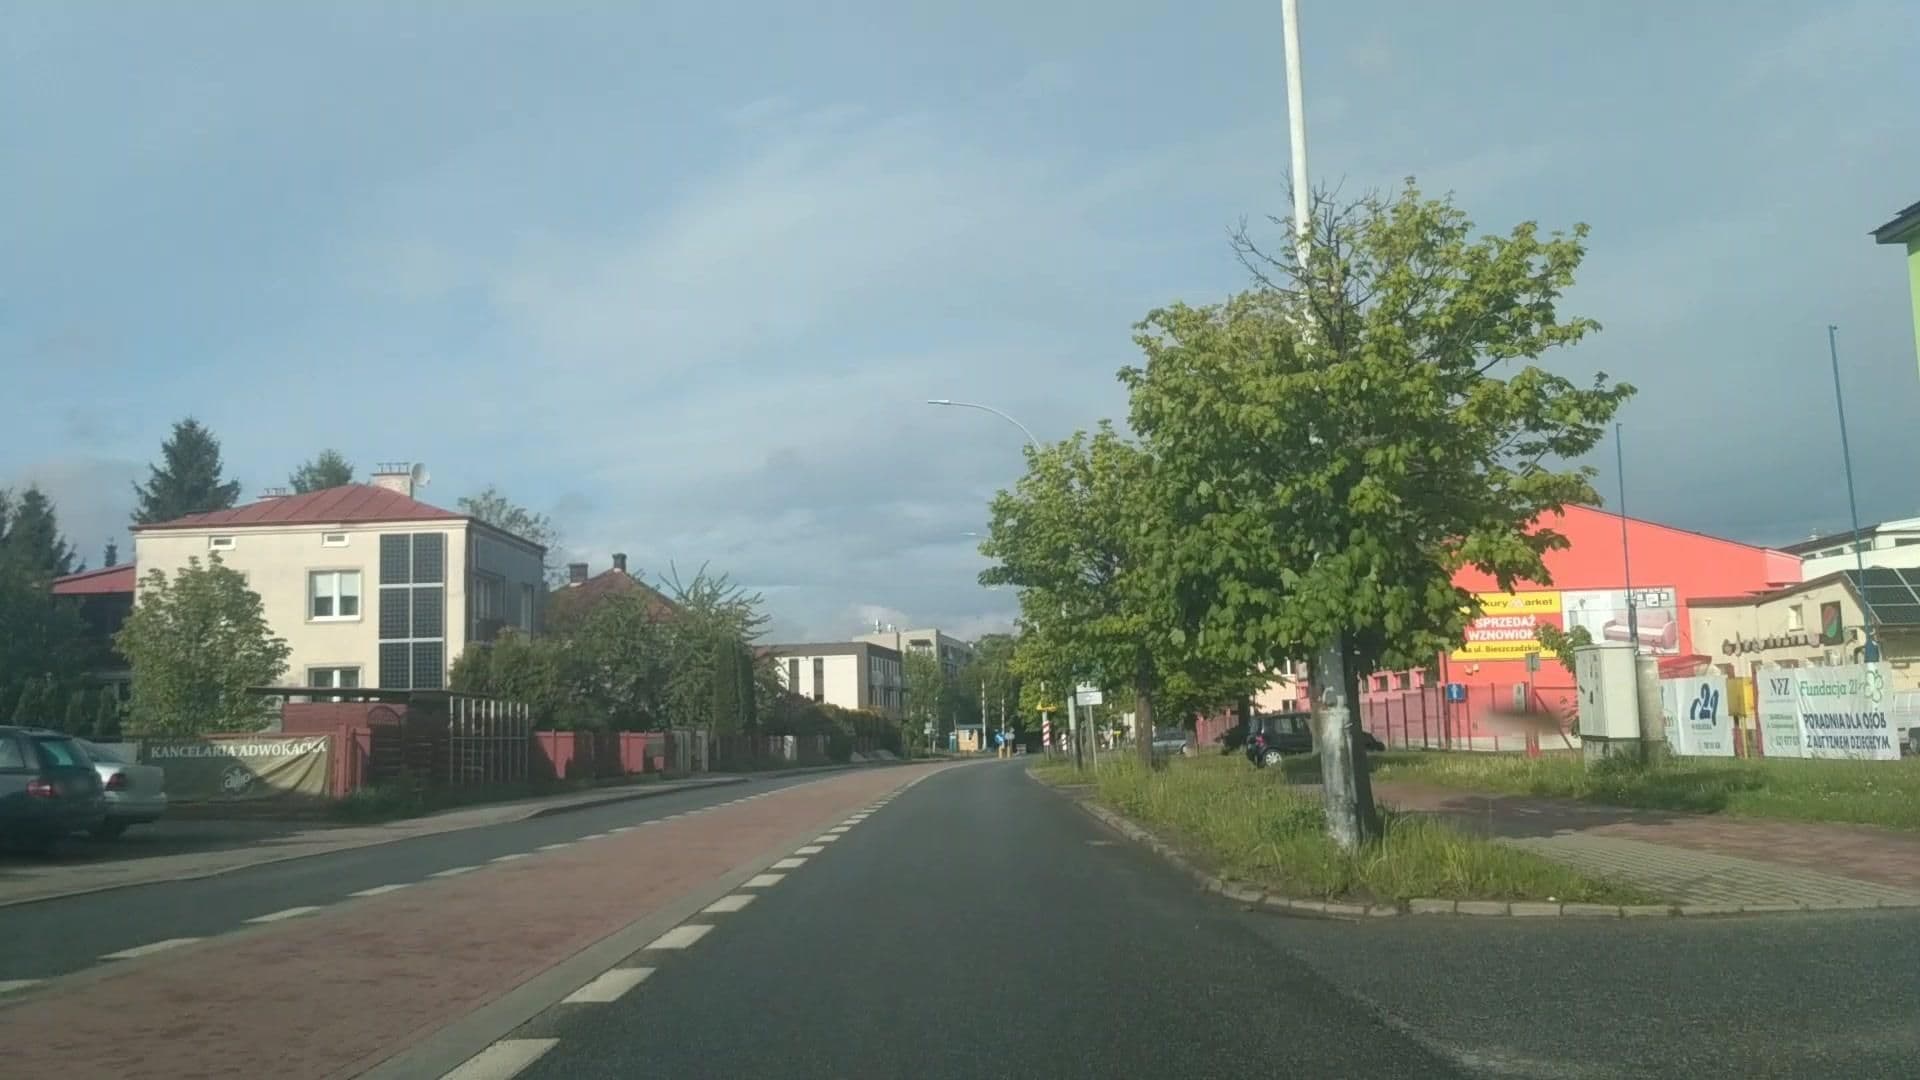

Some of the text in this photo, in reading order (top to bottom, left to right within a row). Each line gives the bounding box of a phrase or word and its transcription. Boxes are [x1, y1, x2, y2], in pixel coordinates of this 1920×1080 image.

[1475, 615, 1536, 627] SPRZEDAŻ
[1800, 680, 1847, 698] Fundacja
[1803, 713, 1845, 729] PORADNIA
[1846, 713, 1861, 729] DLA
[151, 745, 236, 758] KANCELARIA
